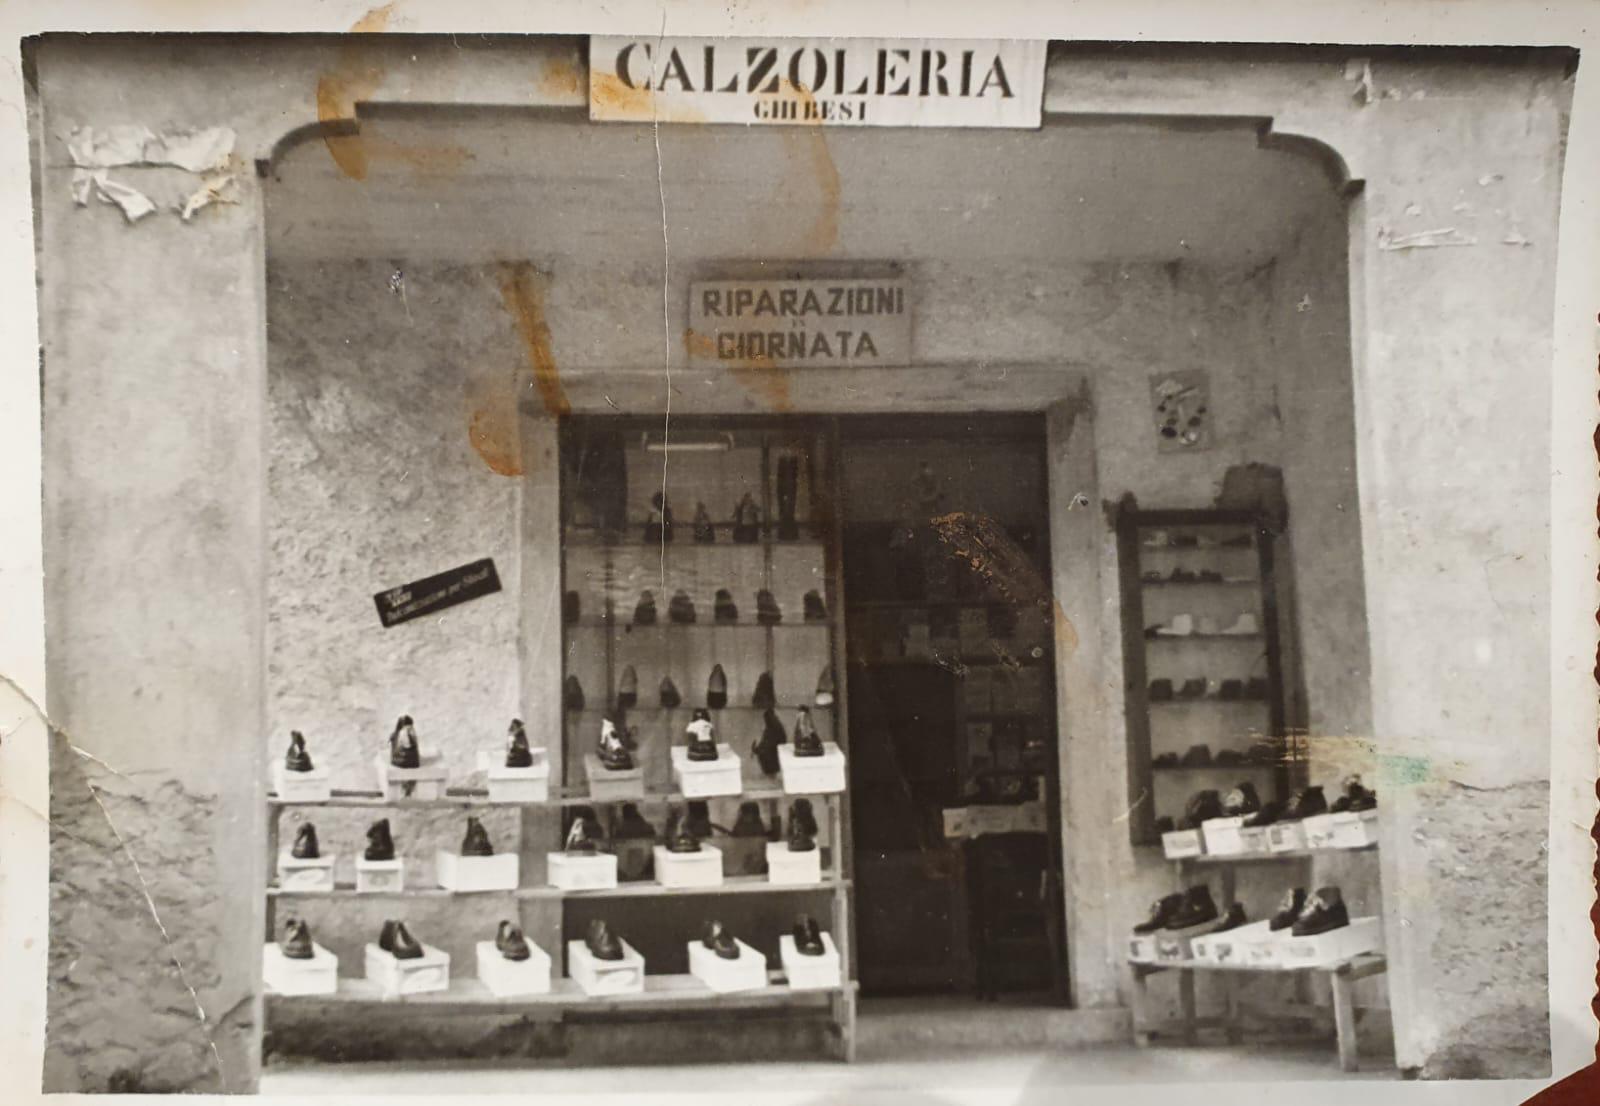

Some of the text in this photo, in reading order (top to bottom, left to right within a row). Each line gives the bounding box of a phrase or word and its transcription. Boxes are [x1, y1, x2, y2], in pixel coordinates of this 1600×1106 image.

[615, 43, 1015, 97] CALZOLERIA
[753, 100, 866, 120] GHIBESI
[703, 287, 904, 317] RIPARAZIONI
[717, 331, 879, 360] GIORNATA
